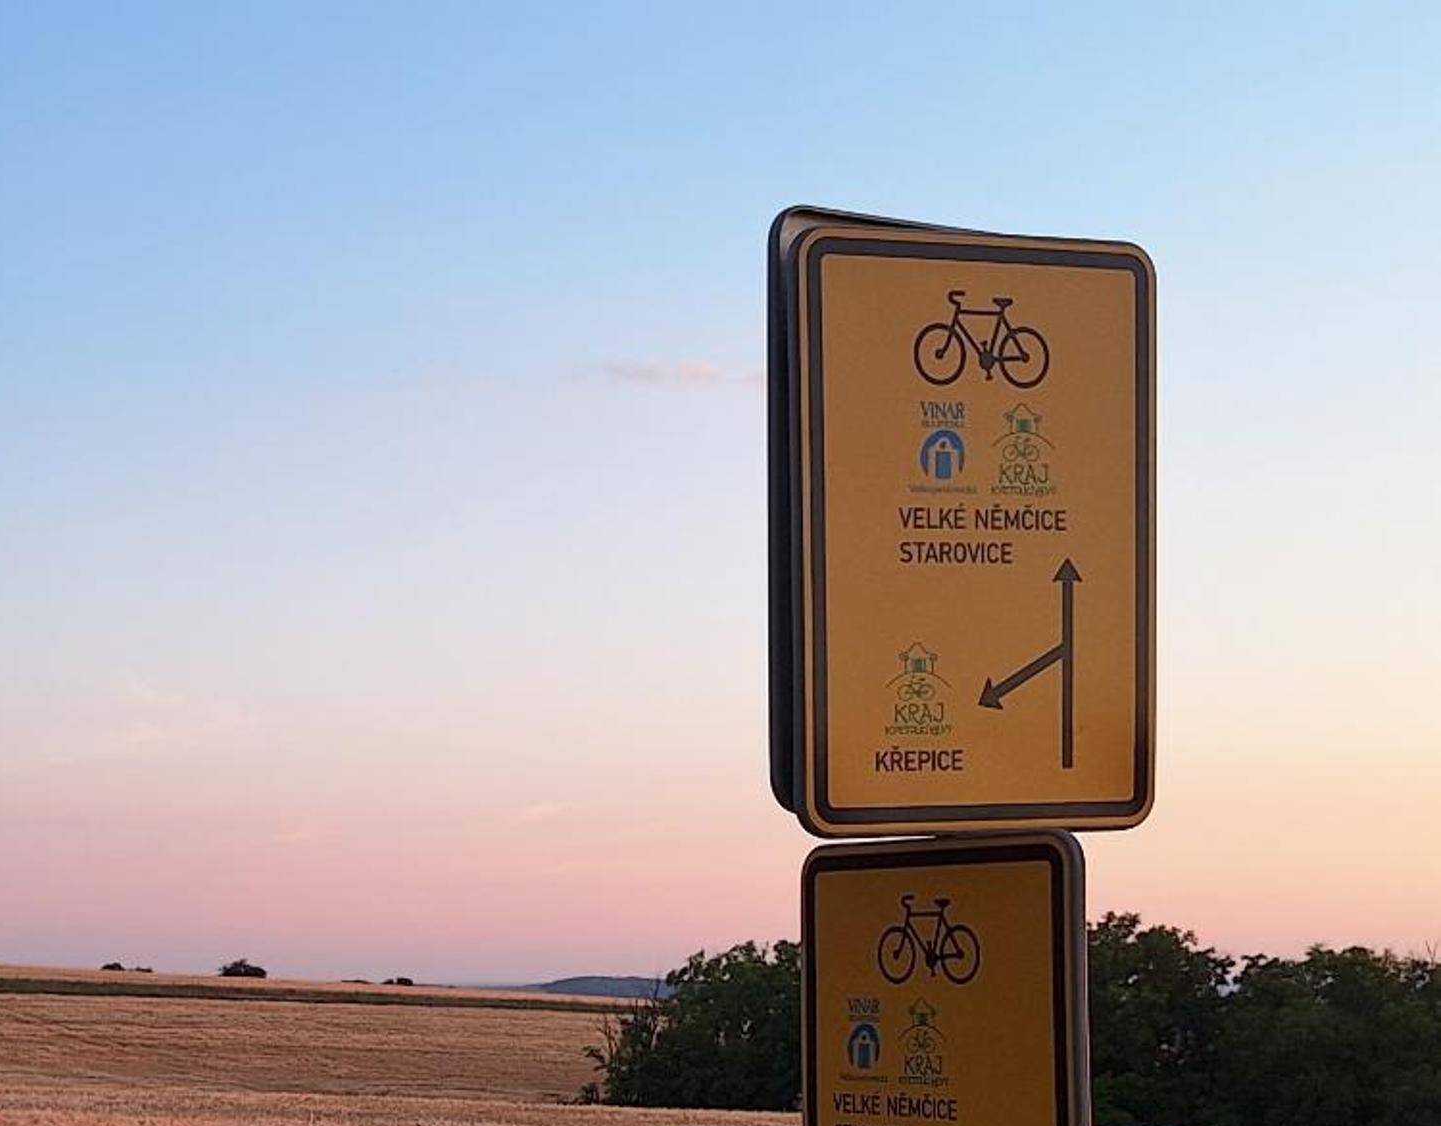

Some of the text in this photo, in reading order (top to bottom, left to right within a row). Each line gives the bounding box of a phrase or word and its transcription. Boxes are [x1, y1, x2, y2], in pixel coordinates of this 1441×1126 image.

[998, 463, 1050, 486] KRAJ
[898, 503, 1068, 532] VELKÉ NĚMČICE
[899, 541, 1014, 565] STAROVICE
[894, 702, 944, 724] KRAJ
[875, 745, 964, 772] KŘEPICE
[833, 1092, 958, 1122] VELKÉ NĚMČICE
